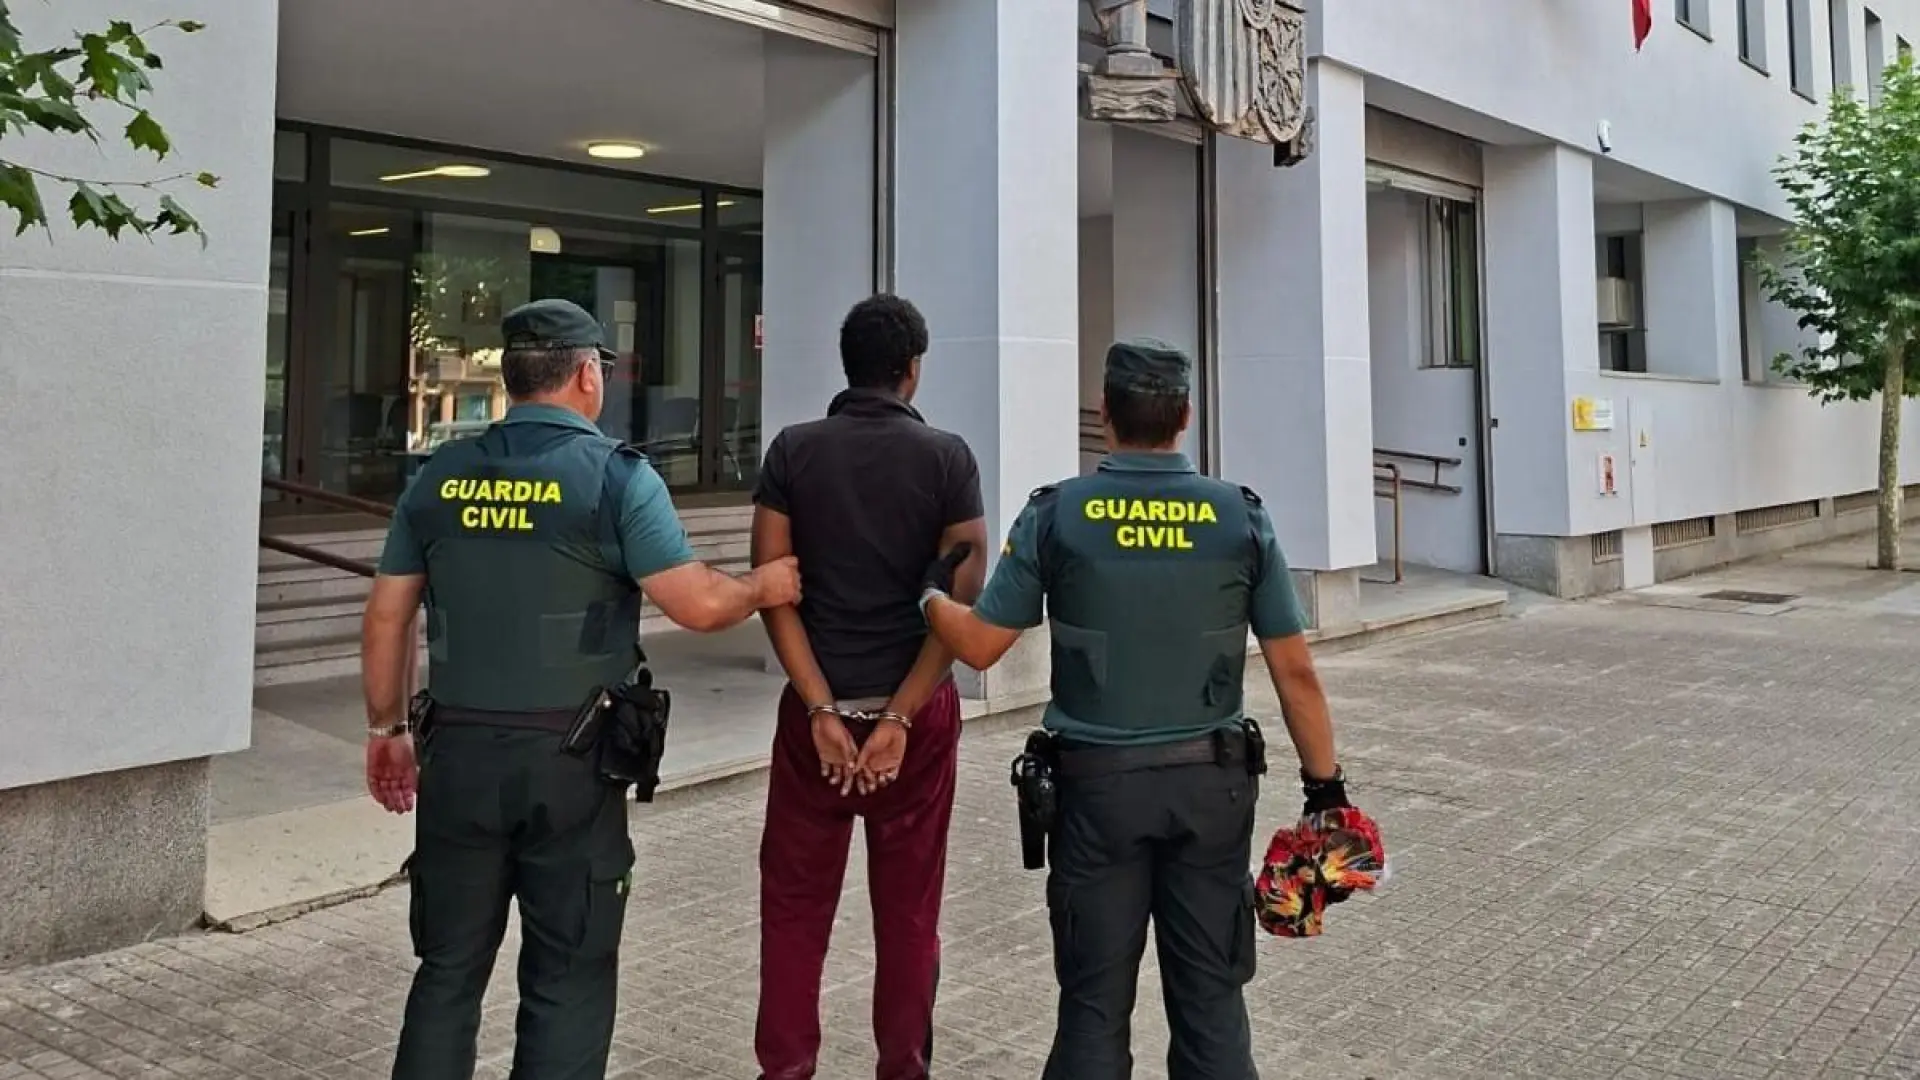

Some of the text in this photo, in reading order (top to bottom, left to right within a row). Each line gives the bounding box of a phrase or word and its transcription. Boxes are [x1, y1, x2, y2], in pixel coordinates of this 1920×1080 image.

[440, 478, 563, 503] GUARDIA
[461, 505, 535, 530] CIVIL
[1084, 498, 1218, 523] GUARDIA
[1116, 524, 1194, 549] CIVIL
